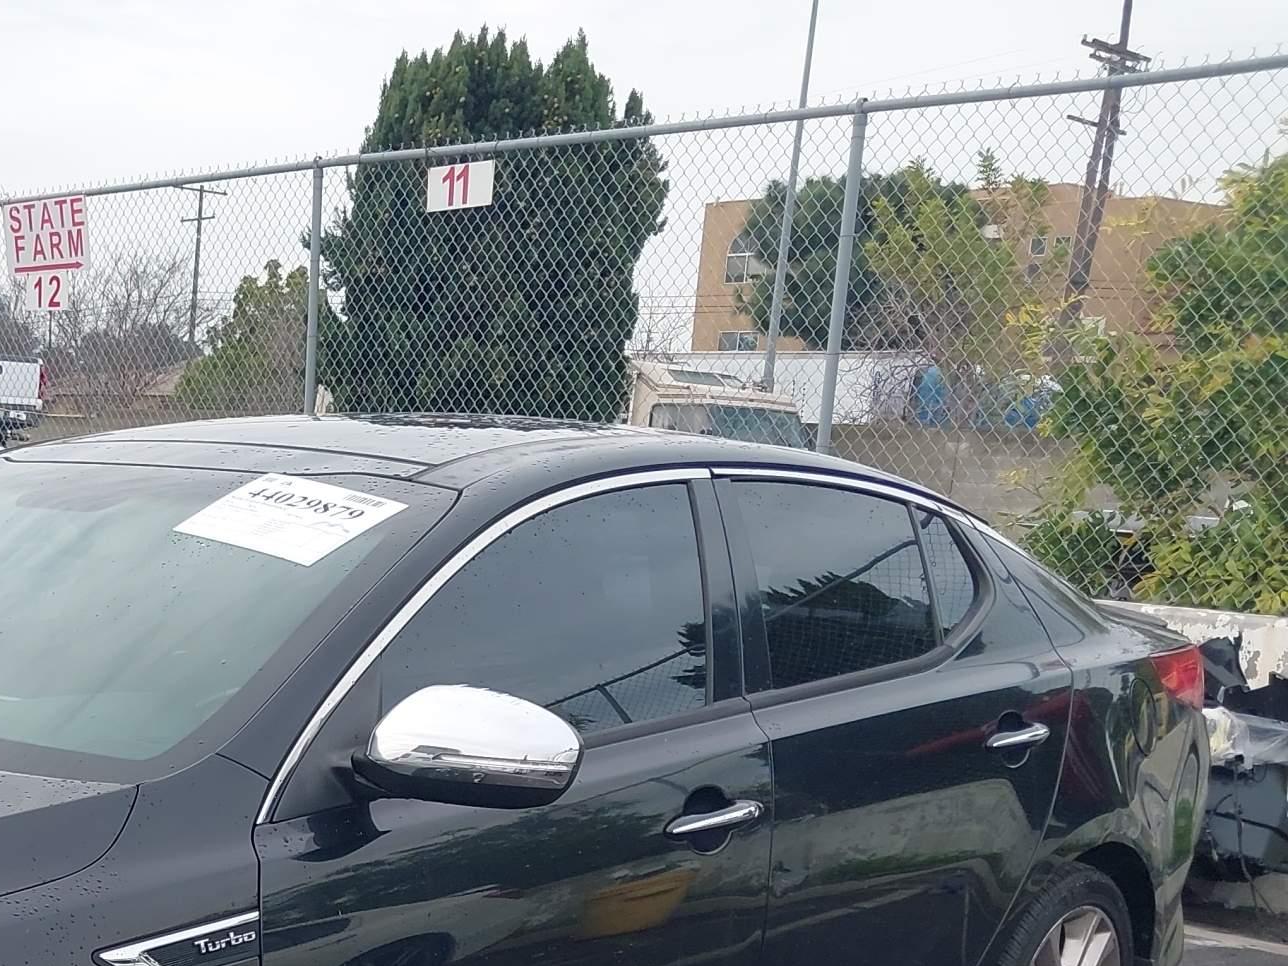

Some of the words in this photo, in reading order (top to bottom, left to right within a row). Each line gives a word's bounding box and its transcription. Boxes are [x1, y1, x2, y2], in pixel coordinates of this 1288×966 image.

[442, 164, 470, 207] 11
[8, 197, 85, 233] STATE
[13, 229, 84, 263] FARM
[33, 275, 61, 308] 12
[248, 487, 366, 520] 44029879
[194, 931, 256, 953] Turbo
